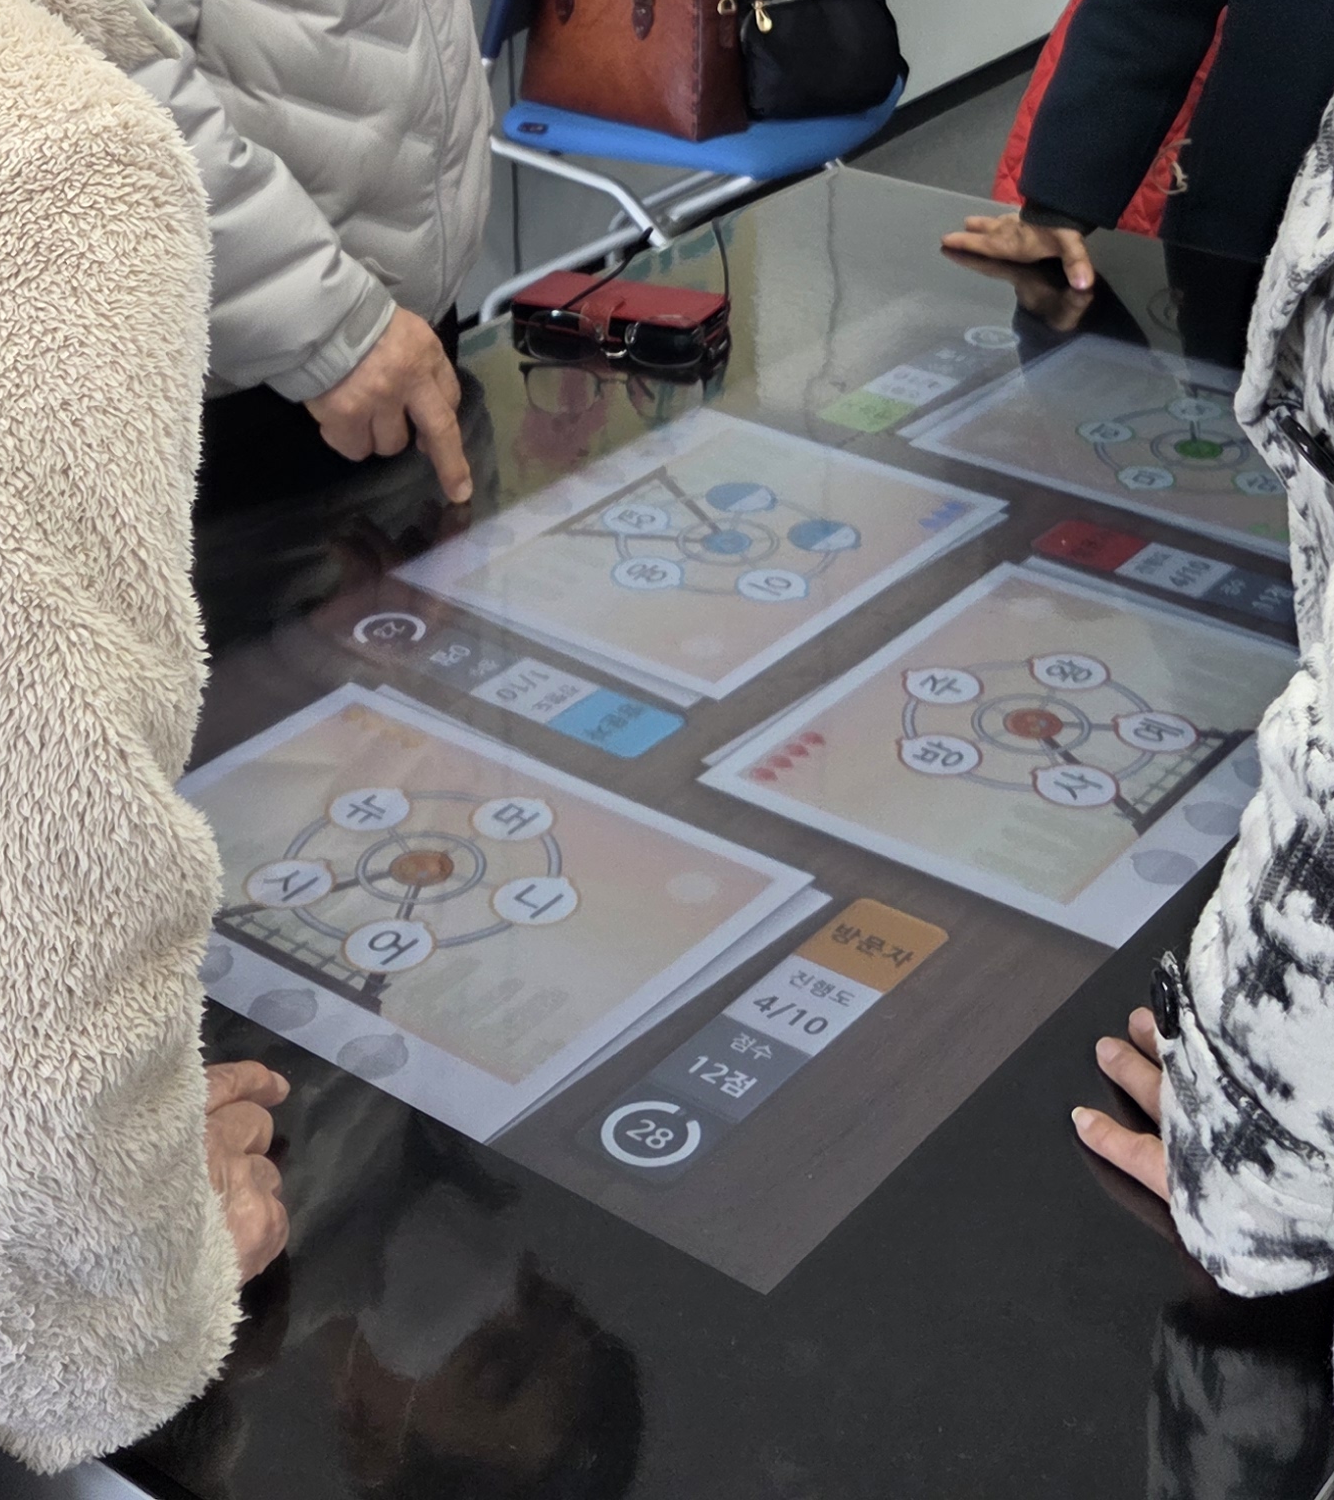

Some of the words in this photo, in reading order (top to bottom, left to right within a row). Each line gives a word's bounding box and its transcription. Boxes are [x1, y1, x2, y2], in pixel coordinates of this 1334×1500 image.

[495, 668, 550, 703] 1/10
[919, 673, 963, 697] 주
[1133, 716, 1186, 743] 예
[912, 740, 965, 768] 방
[1052, 770, 1104, 801] 사
[345, 793, 387, 826] 뉴
[491, 802, 541, 836] 머
[263, 869, 320, 902] 시
[513, 883, 565, 920] 니
[368, 929, 419, 966] 어
[831, 922, 915, 969] 방문자
[788, 969, 857, 1008] 진행도
[751, 995, 829, 1035] 4/10
[729, 1032, 774, 1062] 점수
[687, 1055, 759, 1099] 12점
[625, 1118, 675, 1150] 28
